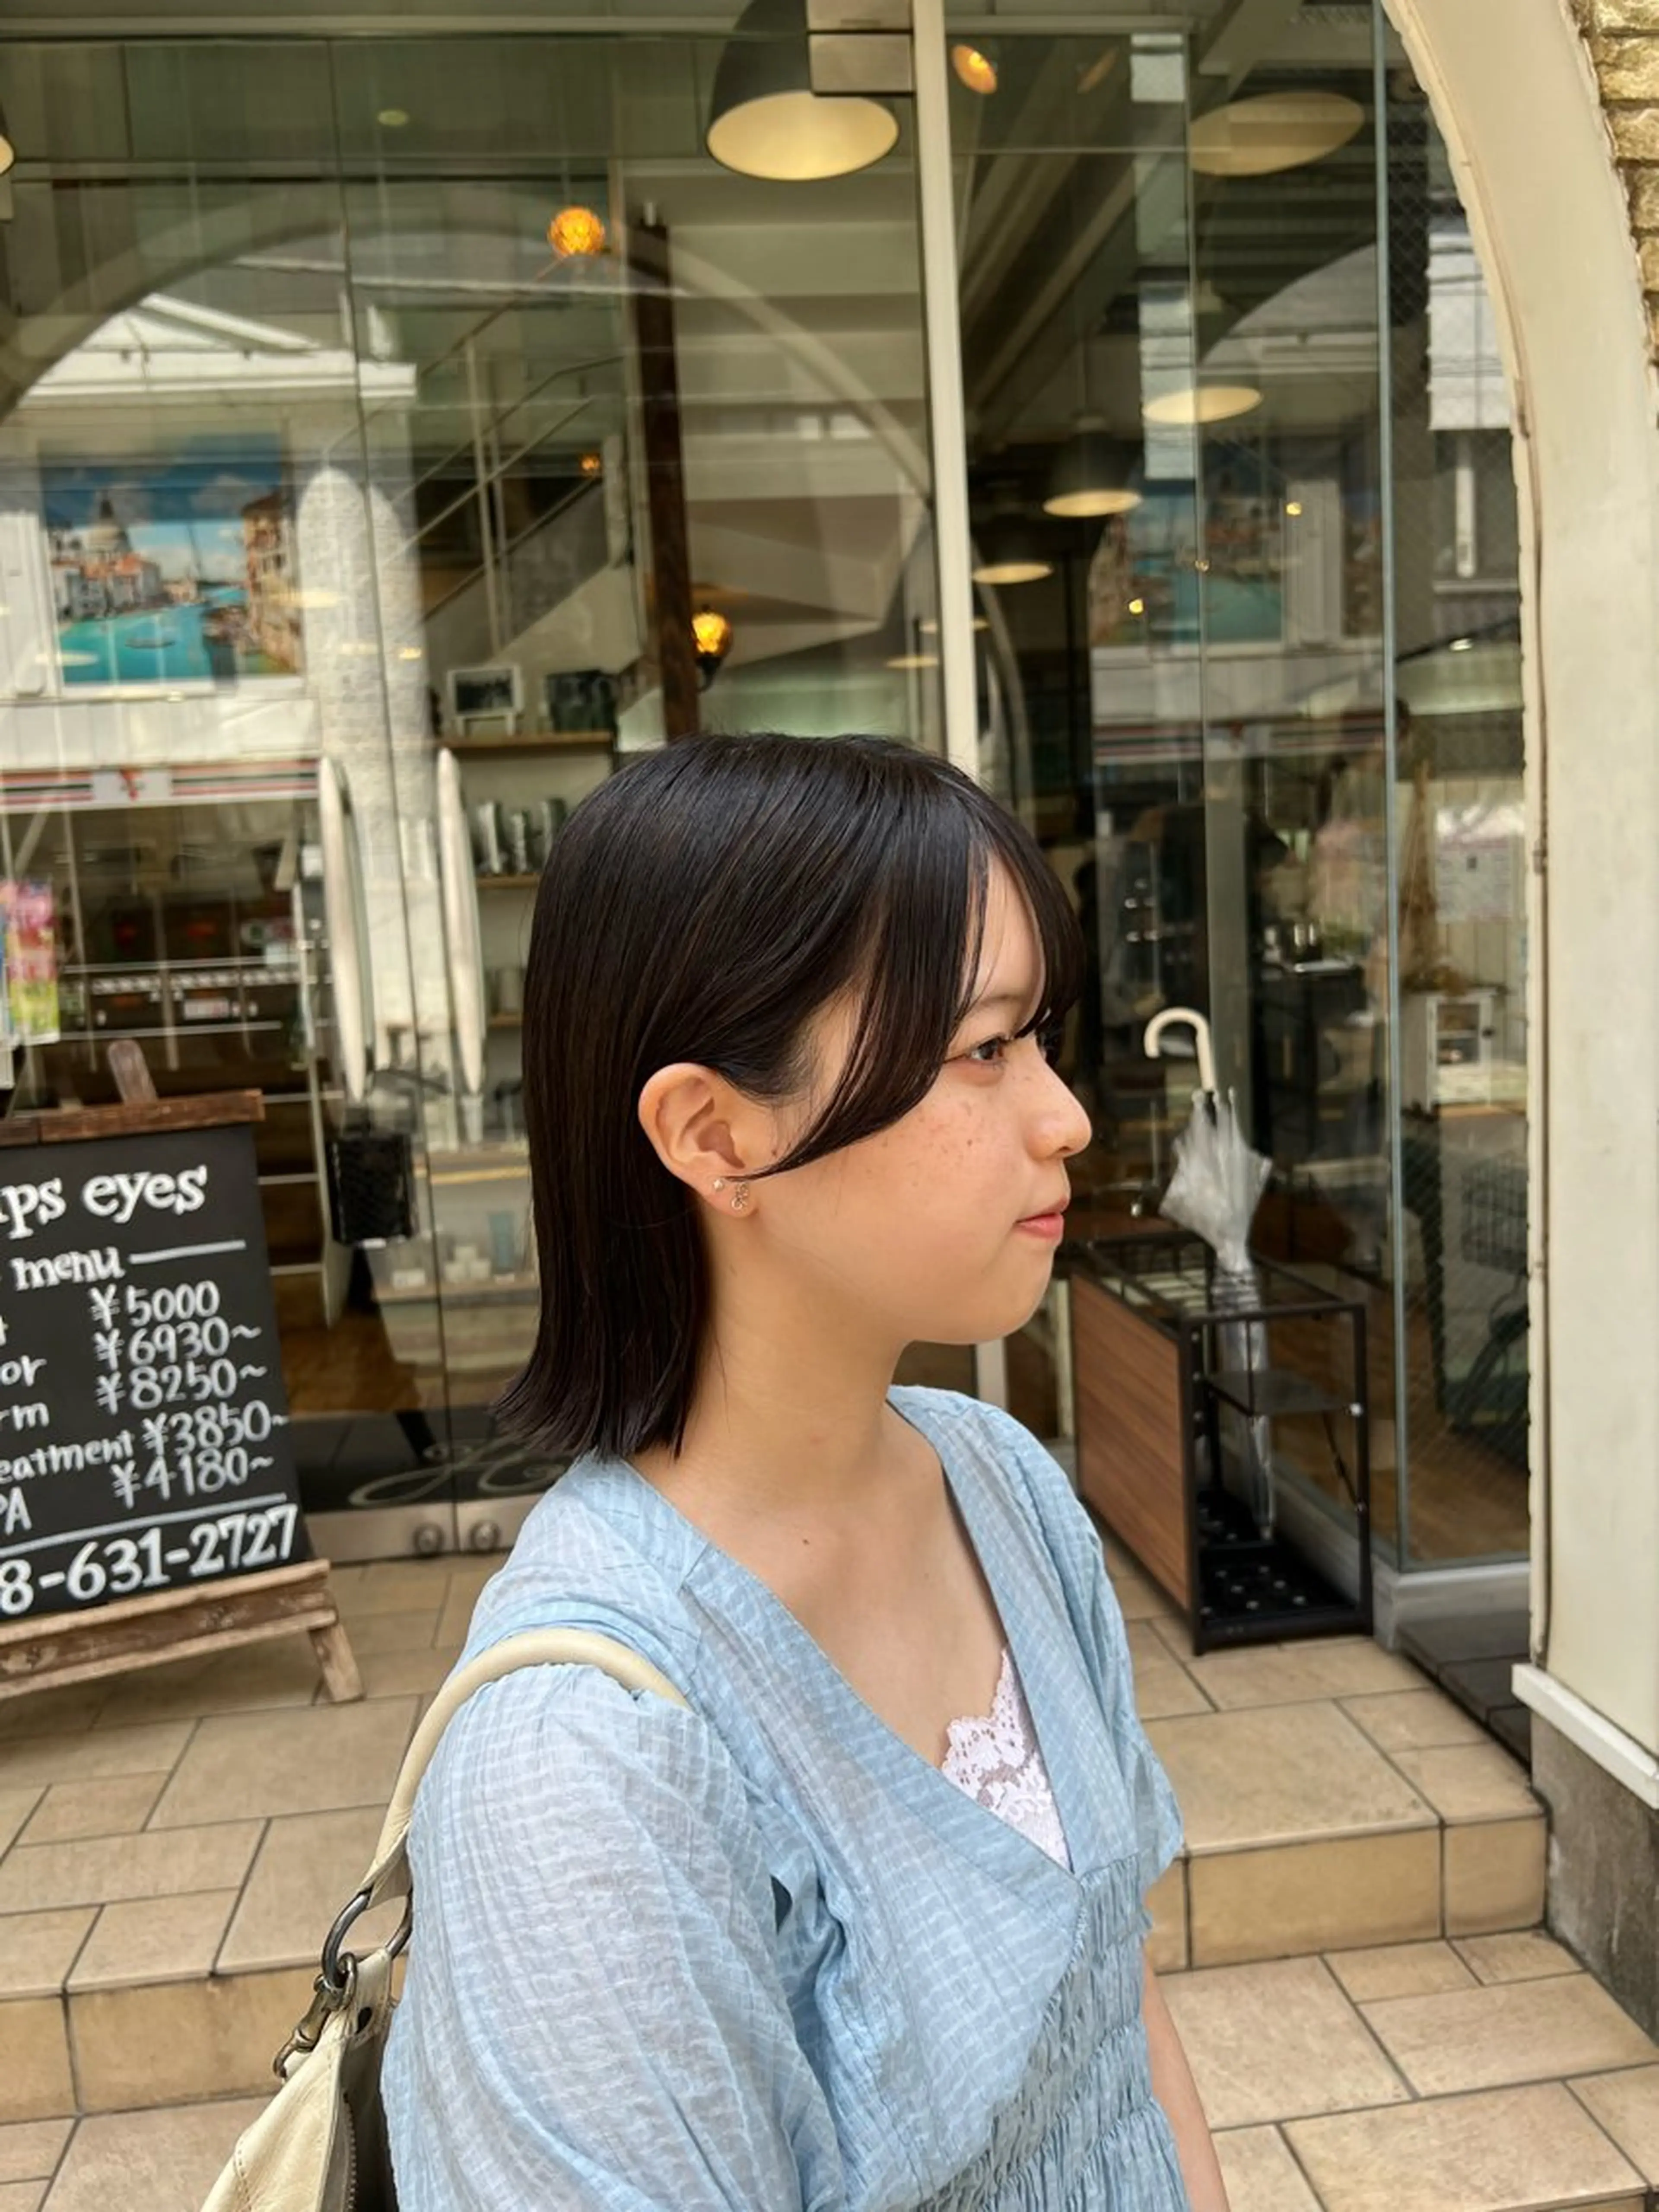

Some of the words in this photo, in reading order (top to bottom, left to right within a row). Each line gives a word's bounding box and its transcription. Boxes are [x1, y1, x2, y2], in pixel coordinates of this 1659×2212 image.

[0, 1177, 67, 1239] ps
[82, 1165, 208, 1223] eyes
[10, 1247, 126, 1290] menu
